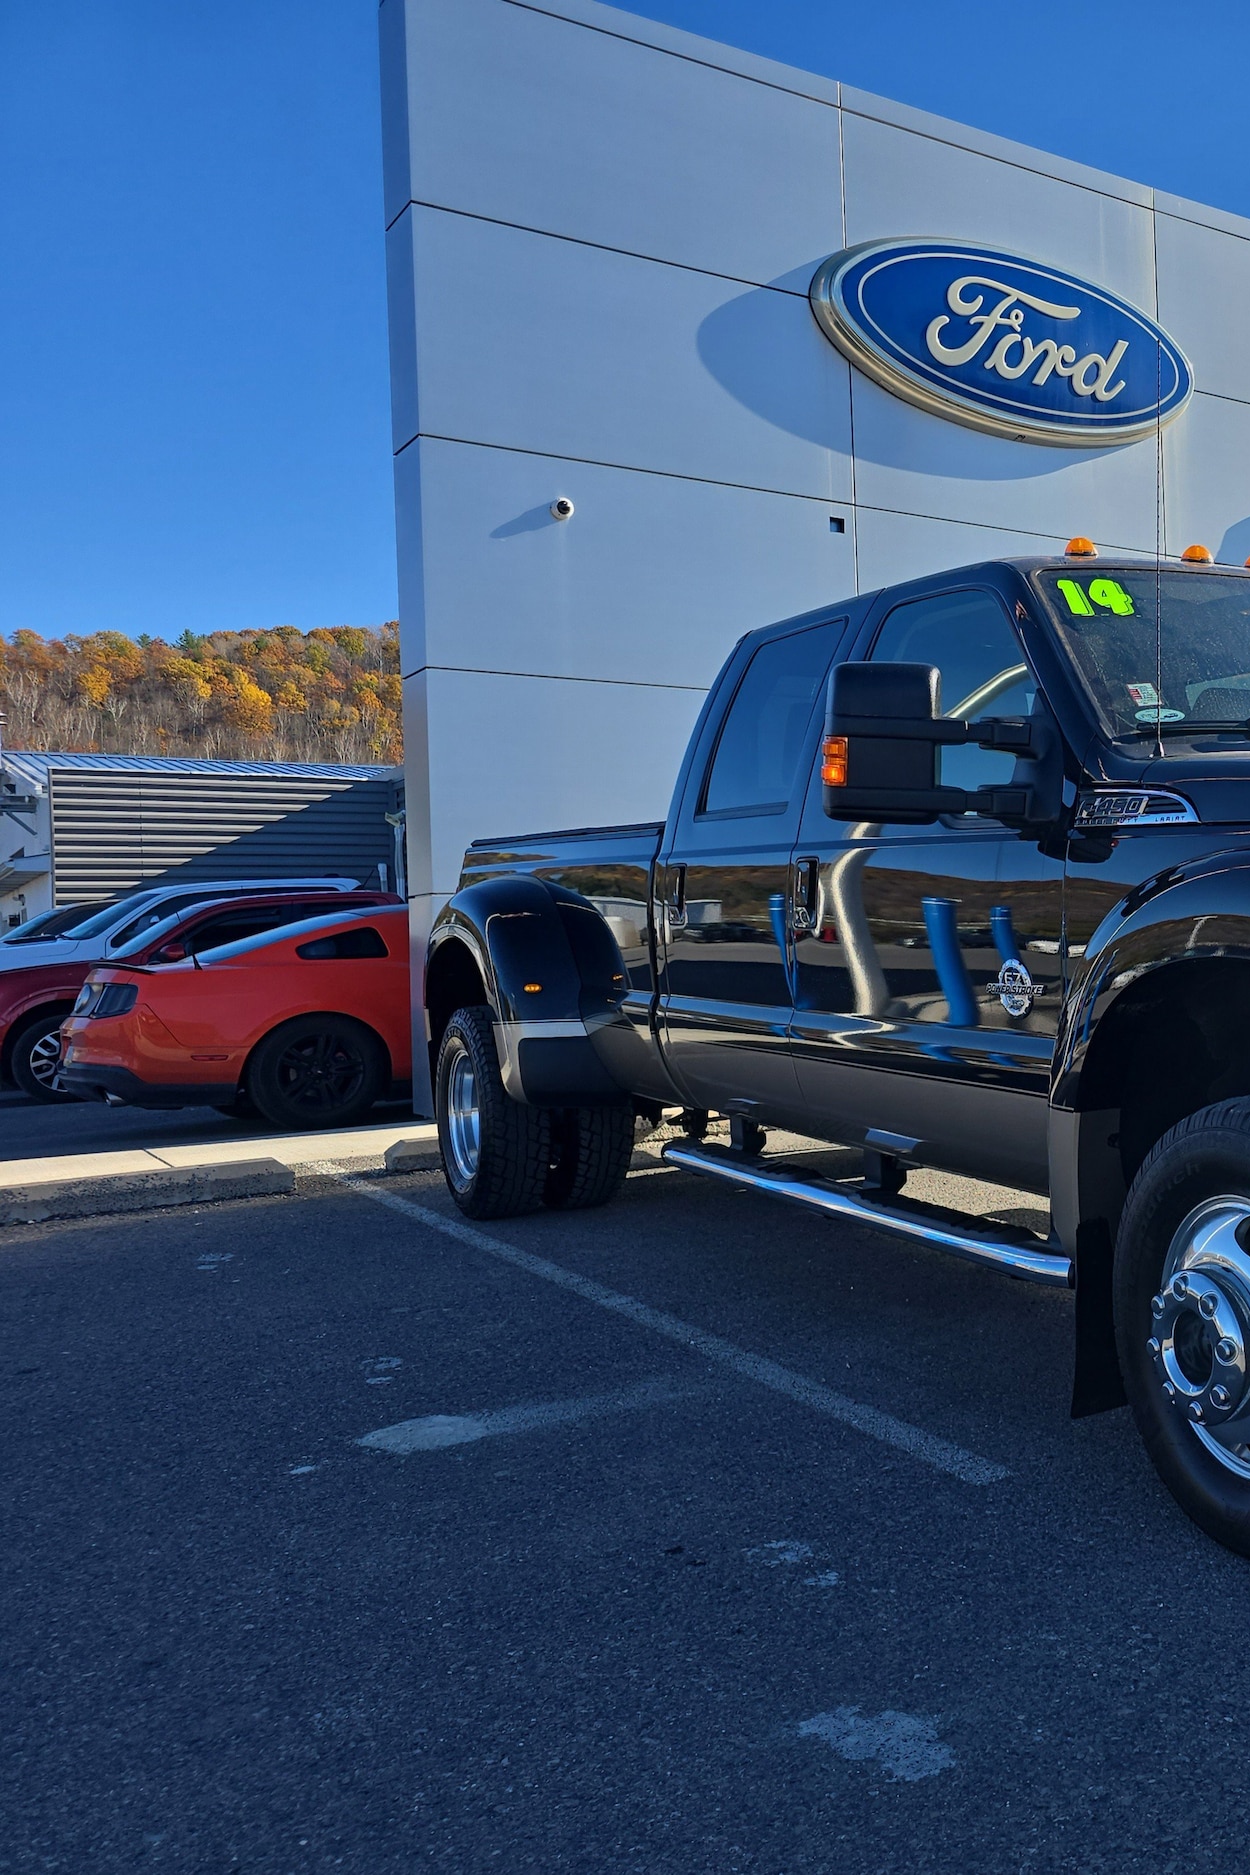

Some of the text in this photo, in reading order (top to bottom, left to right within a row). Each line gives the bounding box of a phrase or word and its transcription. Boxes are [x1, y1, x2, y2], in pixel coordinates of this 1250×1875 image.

[926, 276, 1129, 401] Ford
[1057, 579, 1134, 616] 14
[986, 983, 1044, 996] POWER STROKE
